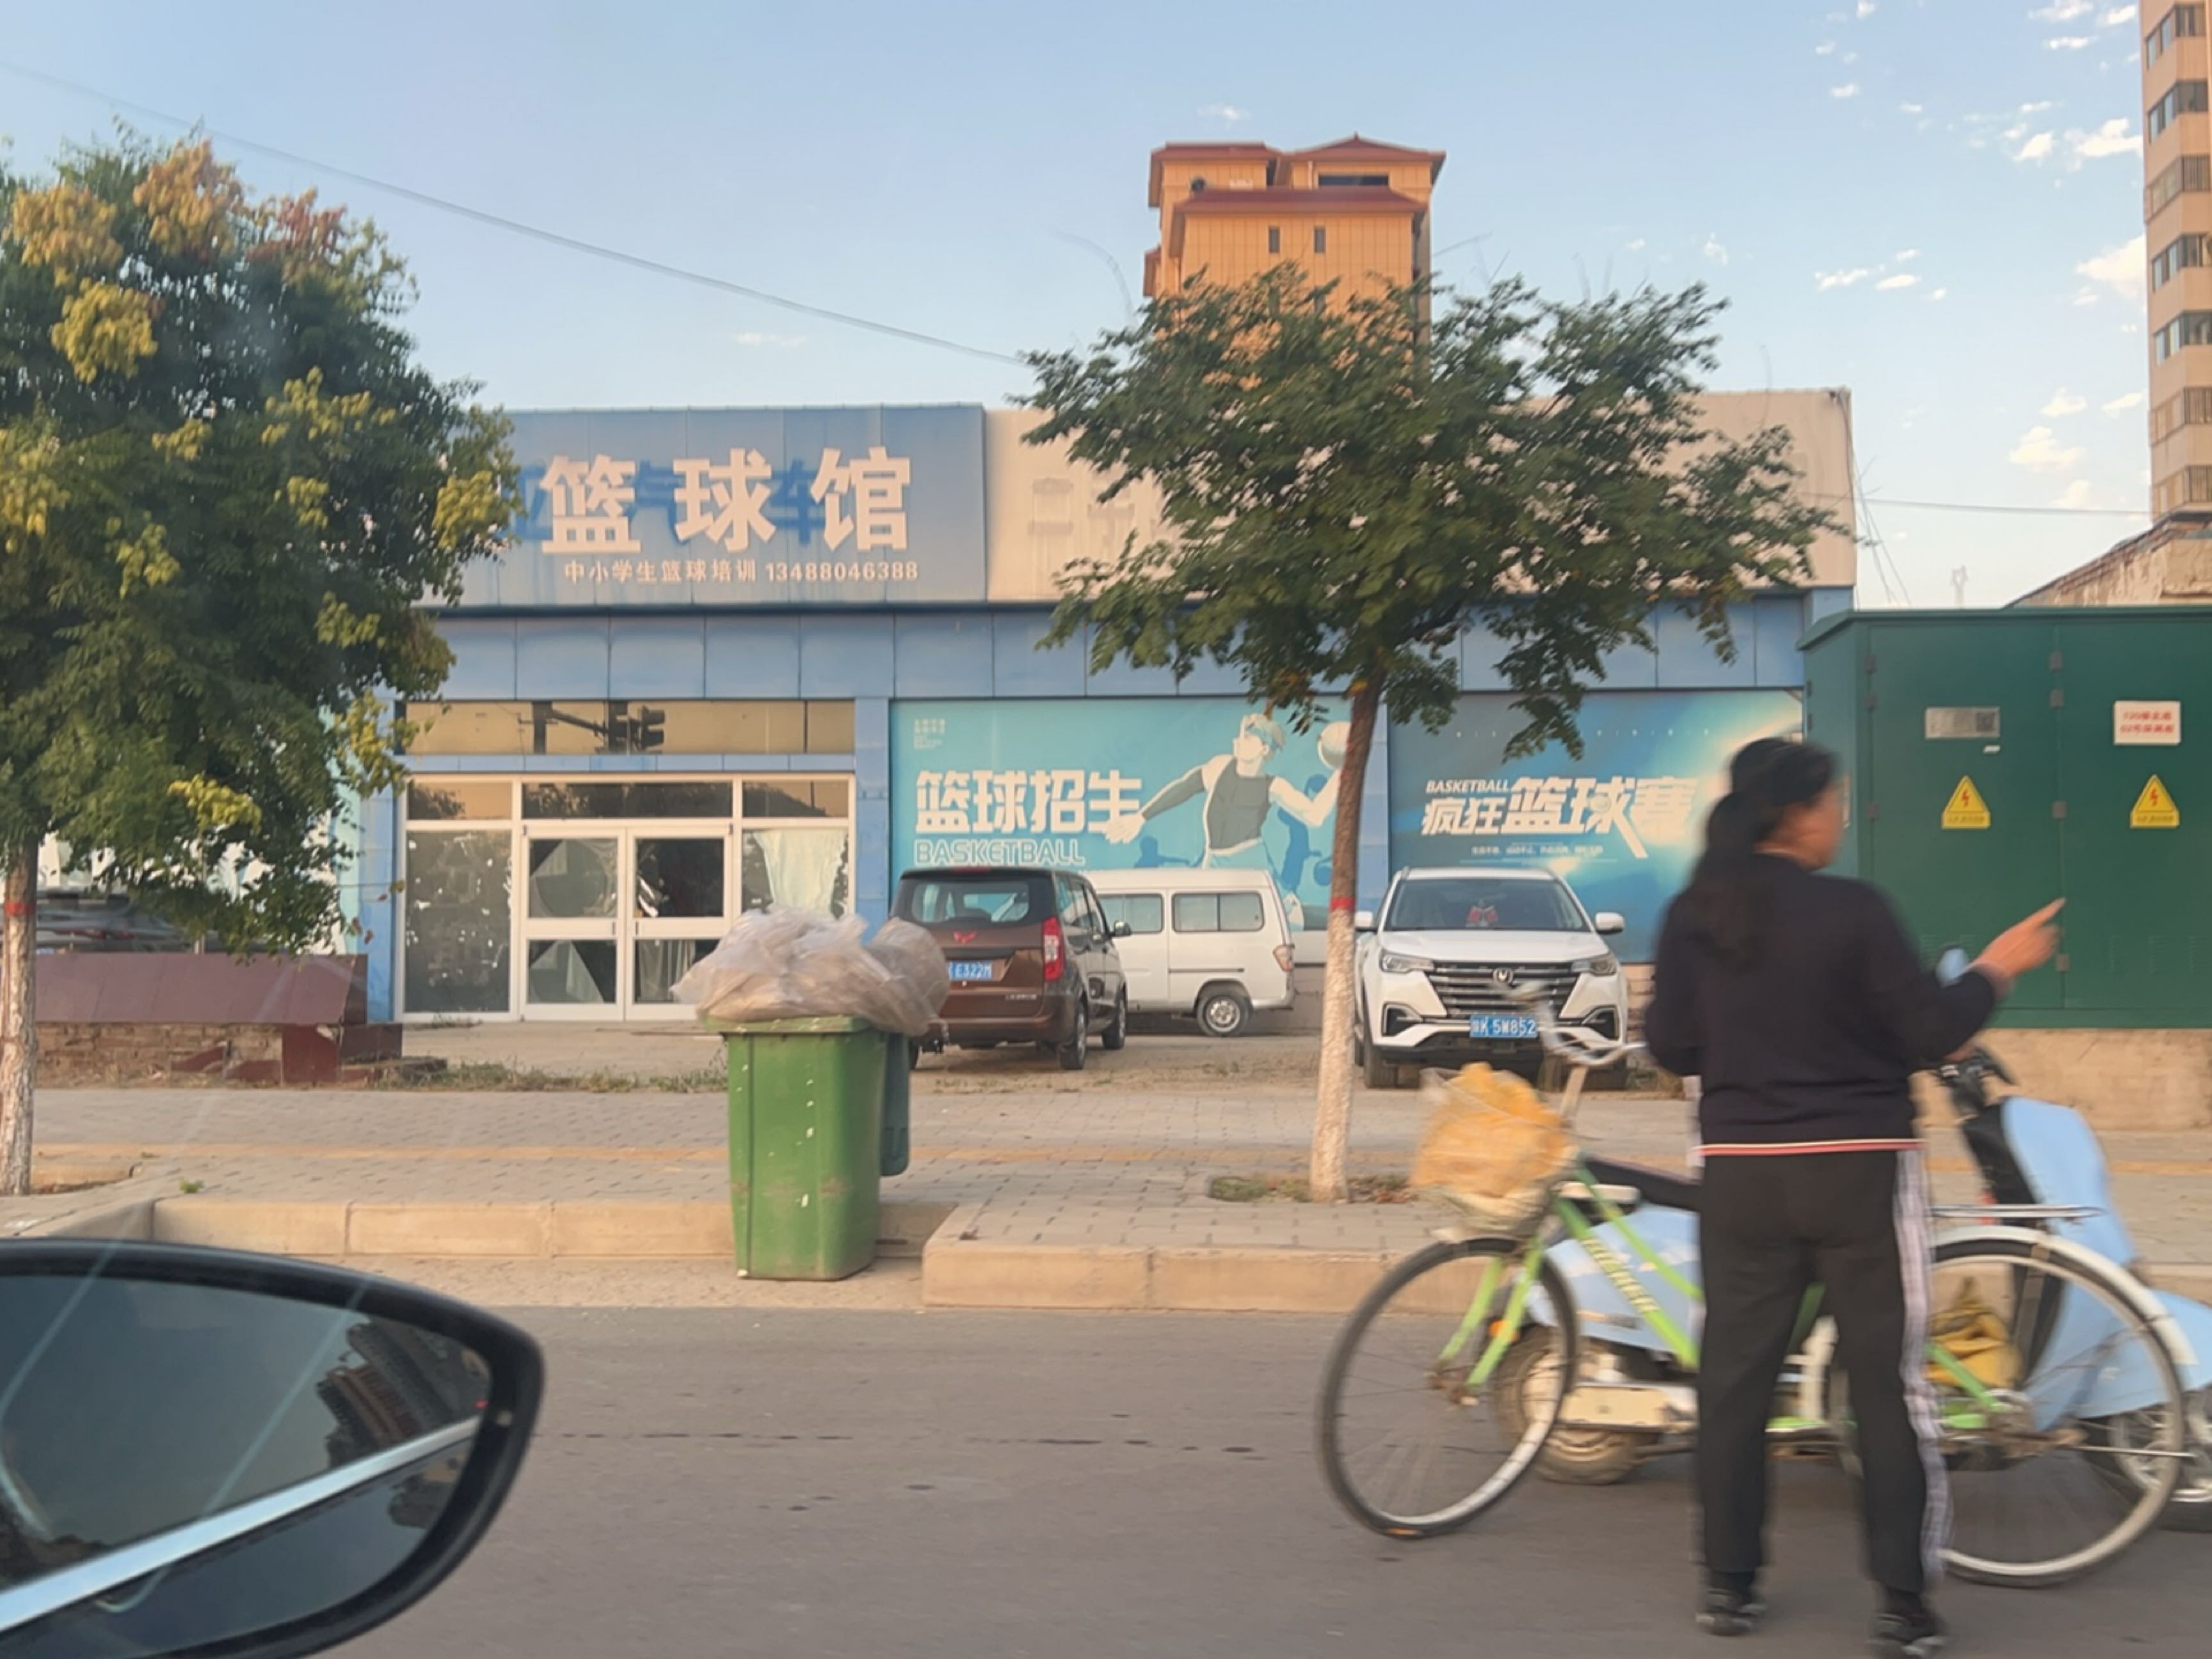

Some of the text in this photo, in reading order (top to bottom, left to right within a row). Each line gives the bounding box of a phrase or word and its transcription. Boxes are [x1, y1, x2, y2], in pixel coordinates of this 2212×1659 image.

[540, 447, 910, 554] 篮球馆
[564, 559, 919, 584] 中小学生篮球培训 13488046388
[1425, 778, 1510, 794] BASKETBALL
[915, 769, 1142, 833] 篮球招生
[914, 838, 1086, 865] BASKETBALL
[949, 961, 991, 979] E322M
